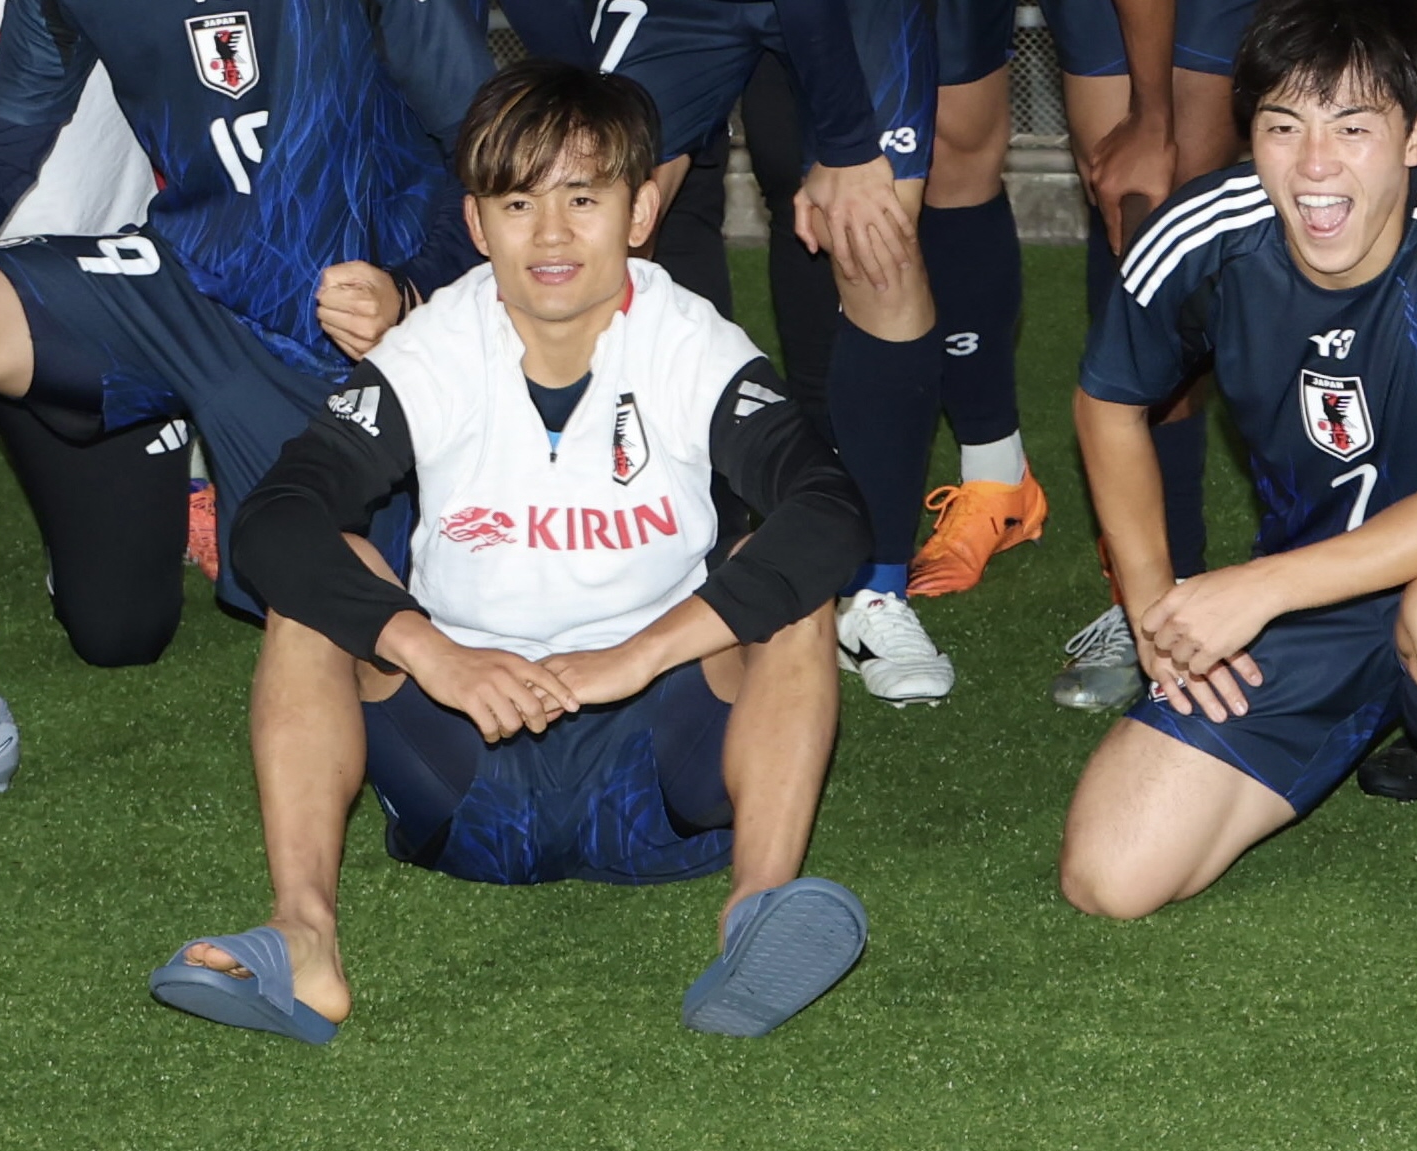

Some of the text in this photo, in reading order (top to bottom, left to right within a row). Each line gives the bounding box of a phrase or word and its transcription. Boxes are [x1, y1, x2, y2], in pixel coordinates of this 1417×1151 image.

[202, 17, 237, 28] JAPAN
[1312, 376, 1345, 391] JAPAN
[527, 495, 679, 551] KIRIN
